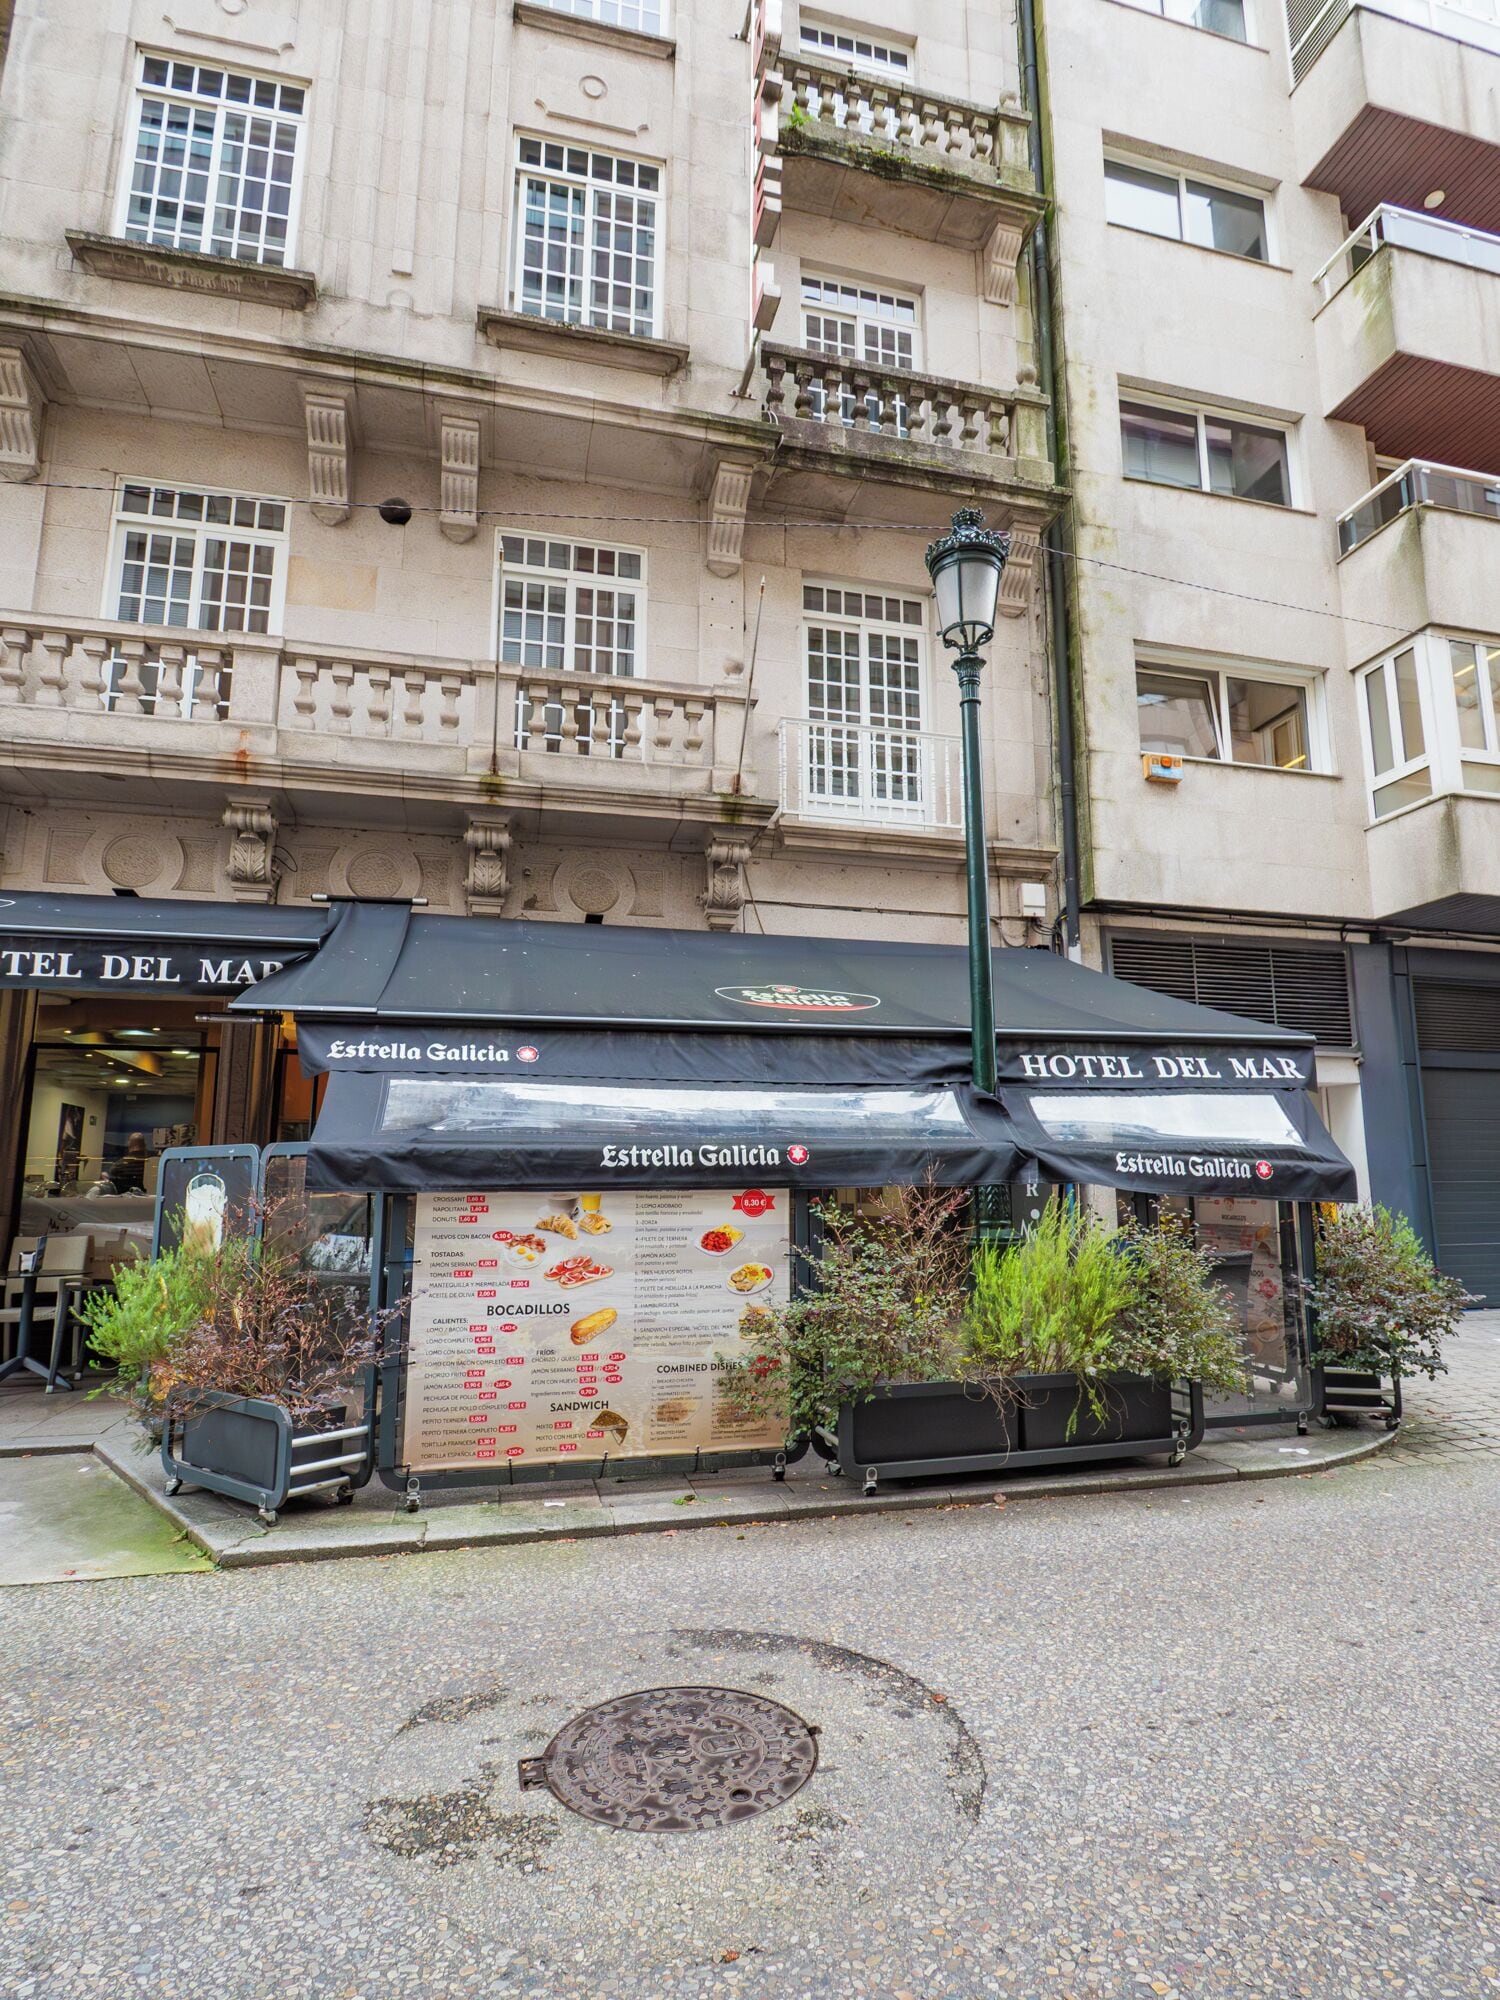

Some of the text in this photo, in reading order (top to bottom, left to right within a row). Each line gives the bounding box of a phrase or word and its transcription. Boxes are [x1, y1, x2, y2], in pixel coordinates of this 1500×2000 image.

[1, 950, 82, 979] TEL
[99, 954, 181, 983] DEL
[741, 989, 850, 1001] Estrella
[327, 1041, 509, 1062] Estrella Galicia
[1020, 1054, 1306, 1080] HOTEL DEL MAR
[600, 1144, 780, 1168] Estrella Galicia
[1115, 1152, 1252, 1179] Estrella Galicia
[487, 1304, 570, 1316] BOCADILLOS
[656, 1364, 708, 1374] COMBINED
[550, 1401, 609, 1412] SANDWICH
